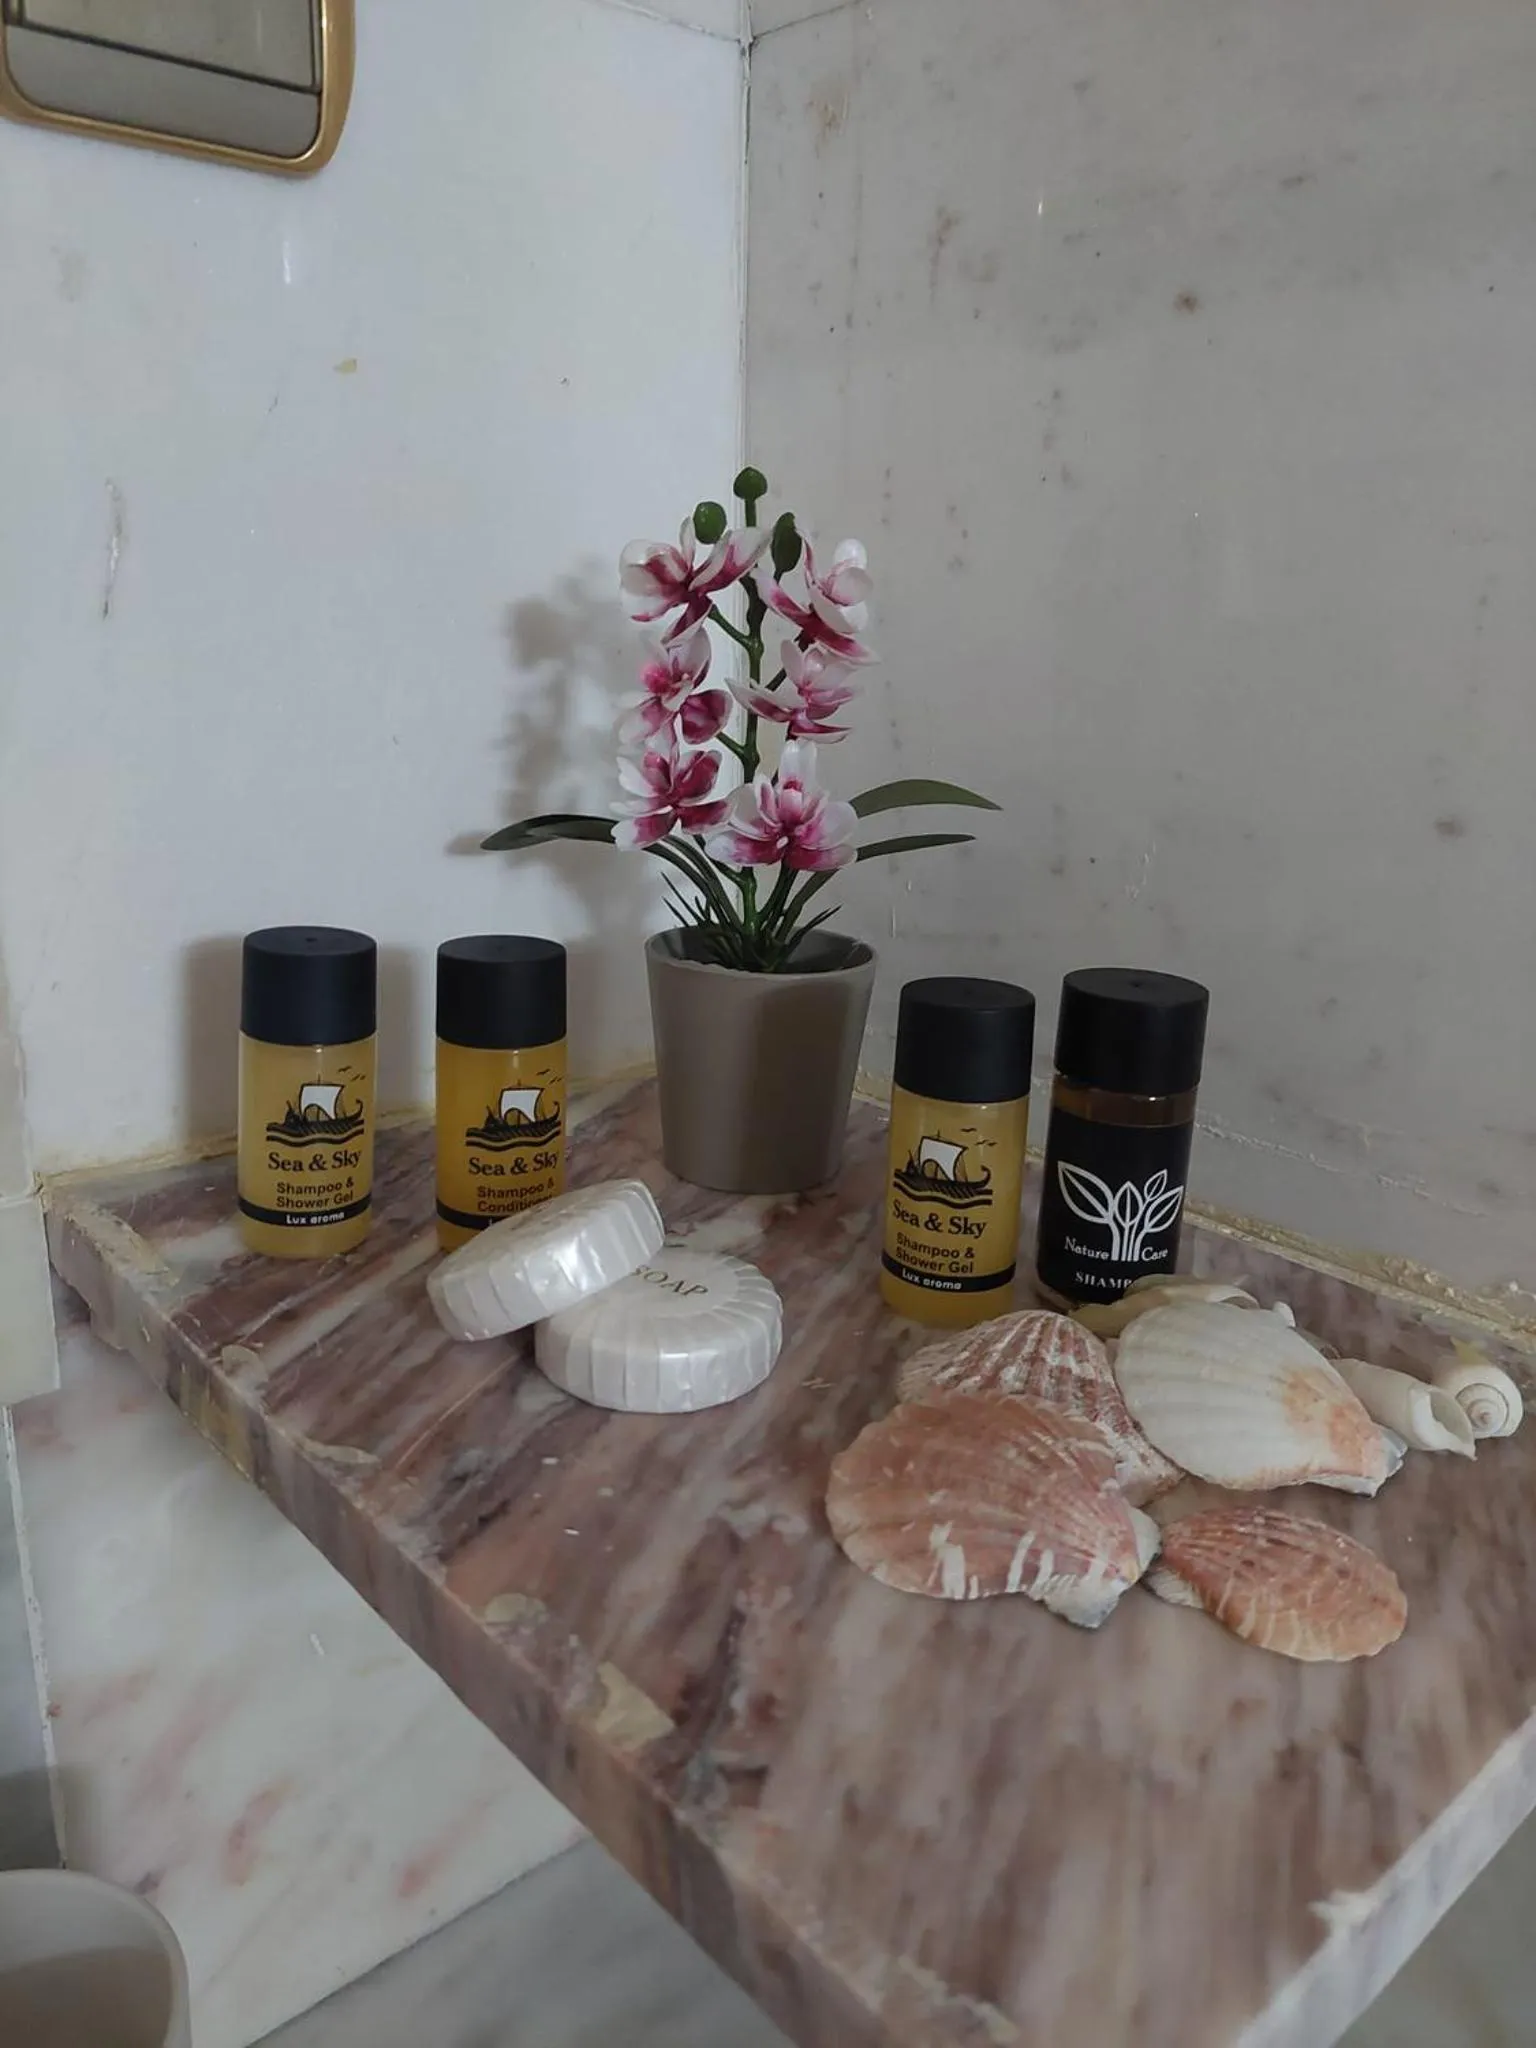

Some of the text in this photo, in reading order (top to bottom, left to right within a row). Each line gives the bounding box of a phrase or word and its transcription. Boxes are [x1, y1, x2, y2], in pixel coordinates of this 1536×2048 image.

[268, 1150, 361, 1172] Sea & Sky
[468, 1152, 559, 1176] Sea & Sky
[276, 1176, 354, 1197] Shampoo &
[477, 1183, 545, 1200] Shampoo
[276, 1190, 353, 1209] Shower Gel
[286, 1211, 345, 1225] Lux aroma
[893, 1200, 986, 1238] Sea & Sky
[897, 1232, 975, 1259] Shampoo &
[1064, 1235, 1169, 1262] Nature Care
[896, 1248, 974, 1274] Shower Gel
[633, 1264, 708, 1297] SOAP
[902, 1268, 962, 1291] Lux aroma
[1074, 1271, 1133, 1289] SHAMP
